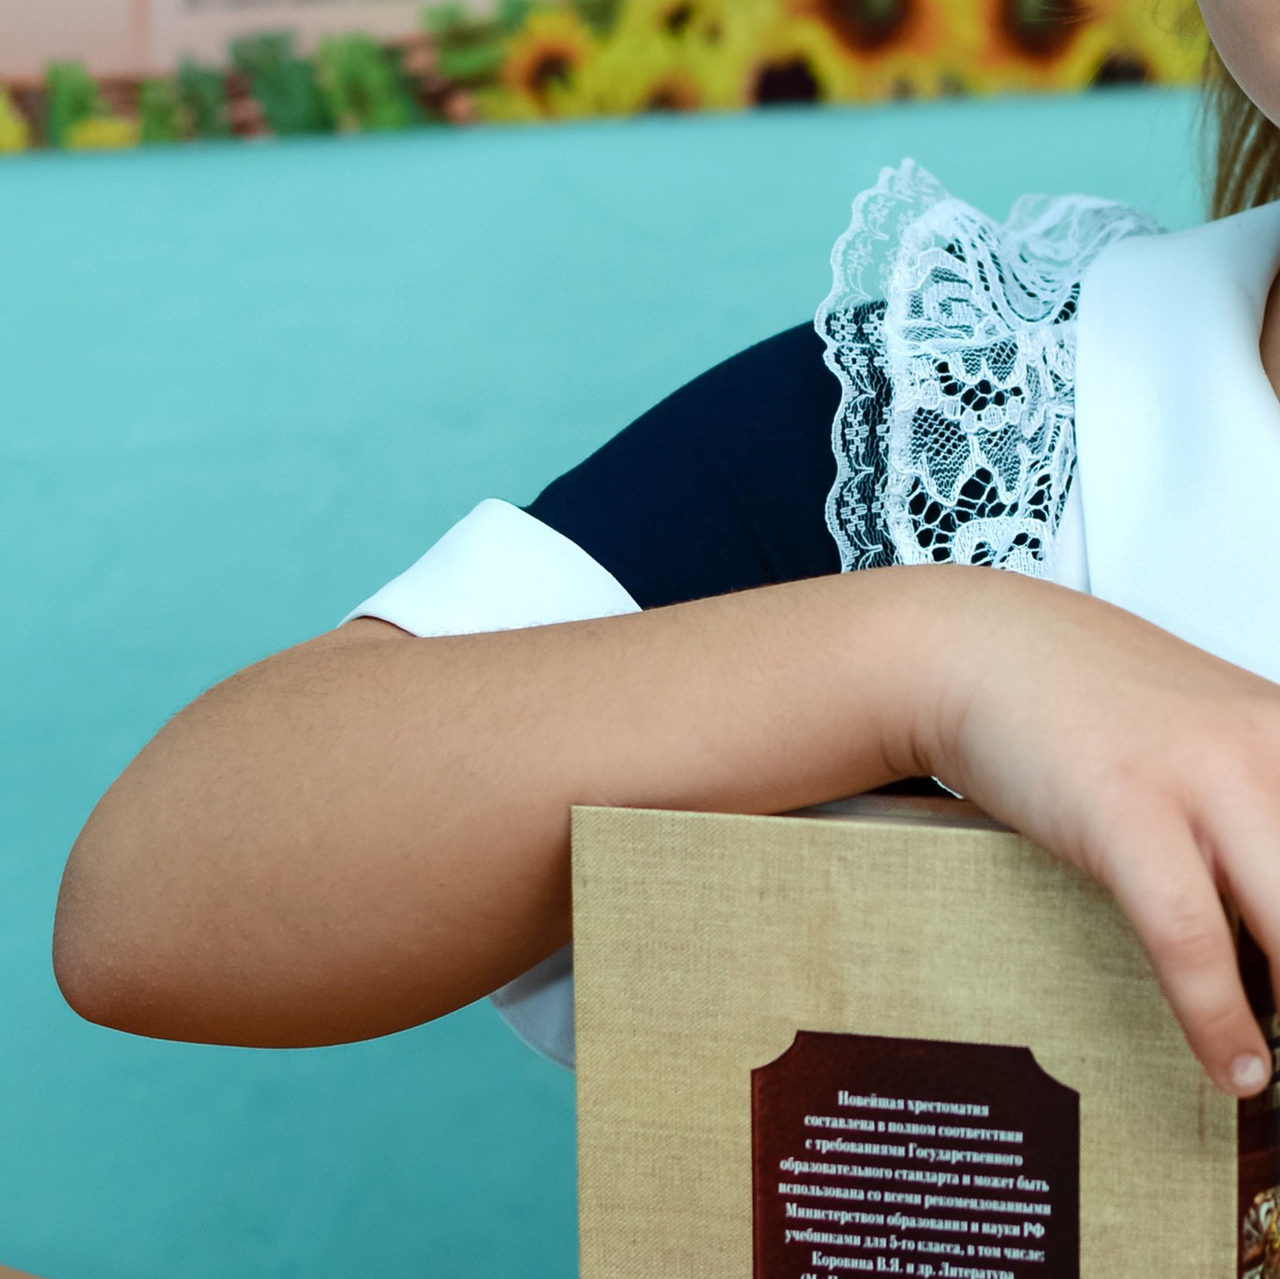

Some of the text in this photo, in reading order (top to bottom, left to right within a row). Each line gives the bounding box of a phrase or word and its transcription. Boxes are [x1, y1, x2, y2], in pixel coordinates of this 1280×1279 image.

[838, 1090, 989, 1117] Новейшая хрестоматия
[804, 1115, 1024, 1143] составлена в полном соответствии
[804, 1137, 1024, 1166] с требованиями Государственного
[779, 1156, 1050, 1192] образовательного стандарта и может быть
[778, 1182, 1051, 1216] использована со всеми рекомендованными
[785, 1201, 1045, 1238] Министерством образования и науки РФ
[784, 1227, 1045, 1261] учебниками для 5-го класса, в том числе:
[812, 1250, 874, 1271] Коровина
[876, 1256, 904, 1273] В.Я.
[906, 1262, 914, 1274] и
[916, 1263, 936, 1279] др.
